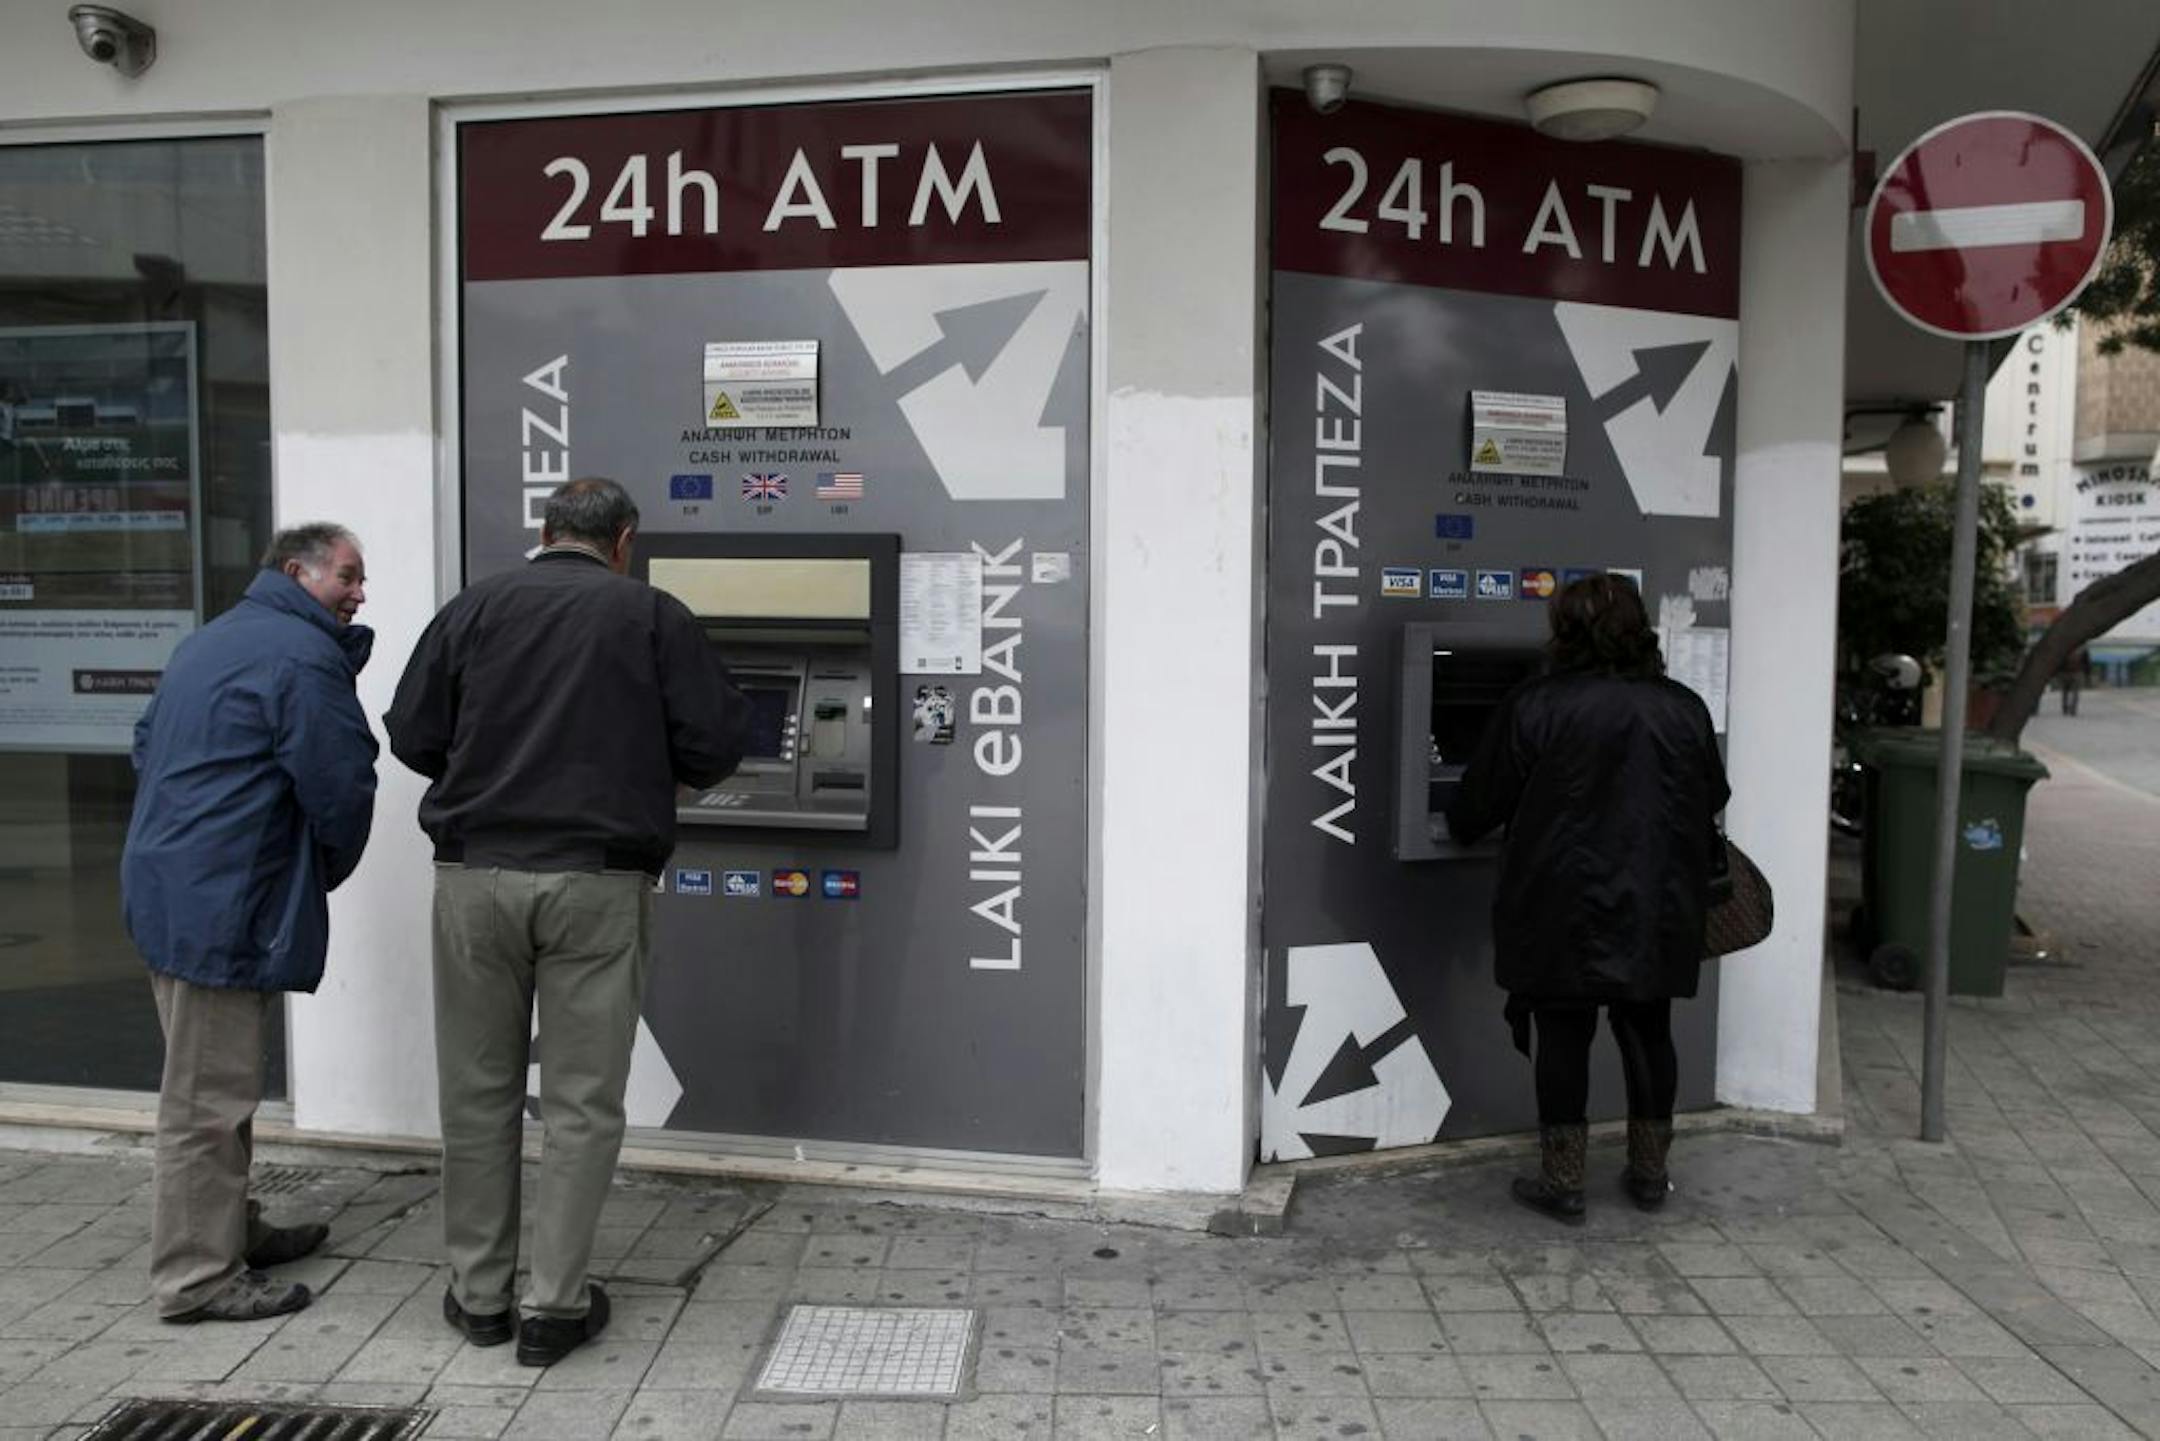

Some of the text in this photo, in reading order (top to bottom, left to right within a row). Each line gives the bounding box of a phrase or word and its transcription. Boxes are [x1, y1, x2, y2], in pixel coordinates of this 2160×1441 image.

[540, 138, 1003, 242] 24h ATM
[1319, 145, 1708, 275] 24h ATM
[689, 449, 840, 464] CASH WITHDRAWAL
[2021, 335, 2044, 476] Centrum
[1313, 321, 1364, 619] ΤΡΑΠΕΖΑ
[1455, 492, 1580, 511] CASH WITHDRAWAL
[2096, 492, 2146, 506] KIOSK
[1389, 577, 1414, 588] VISA
[969, 537, 1024, 970] LAIKI eBANK
